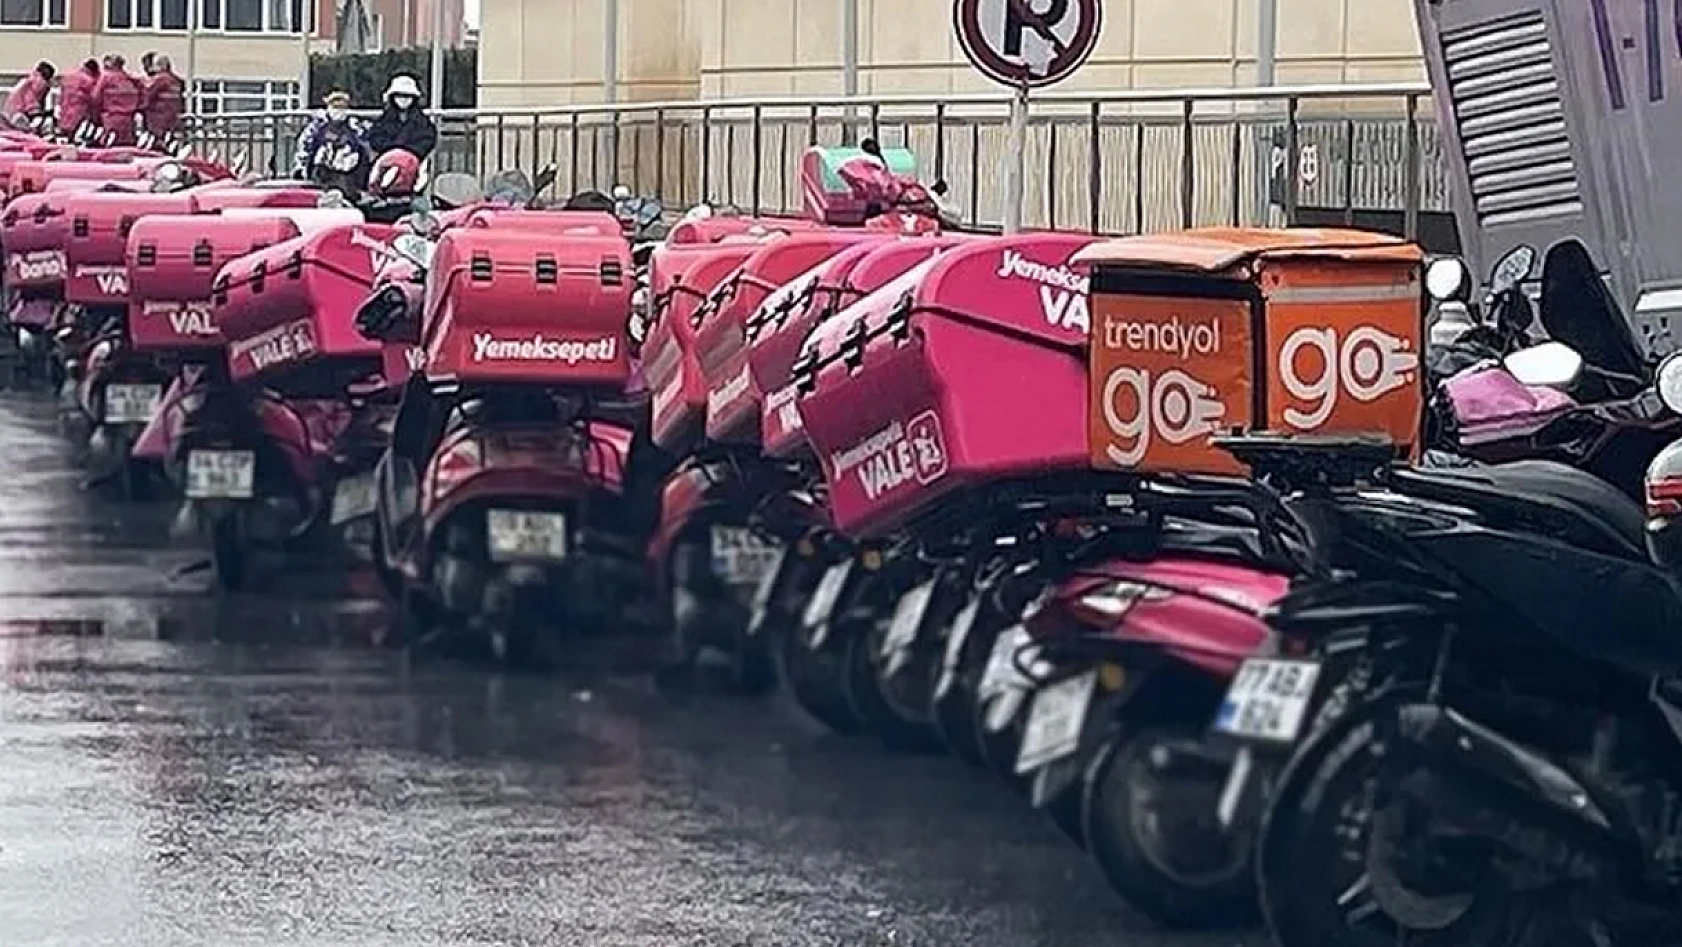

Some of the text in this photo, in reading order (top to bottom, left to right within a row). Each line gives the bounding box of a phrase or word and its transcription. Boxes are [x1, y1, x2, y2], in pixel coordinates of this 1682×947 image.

[249, 334, 294, 371] VALE
[473, 332, 616, 363] Yemeksepeti
[1104, 315, 1221, 359] trendyol
[1278, 325, 1419, 430] go
[1103, 366, 1226, 466] go
[858, 439, 914, 500] VALE
